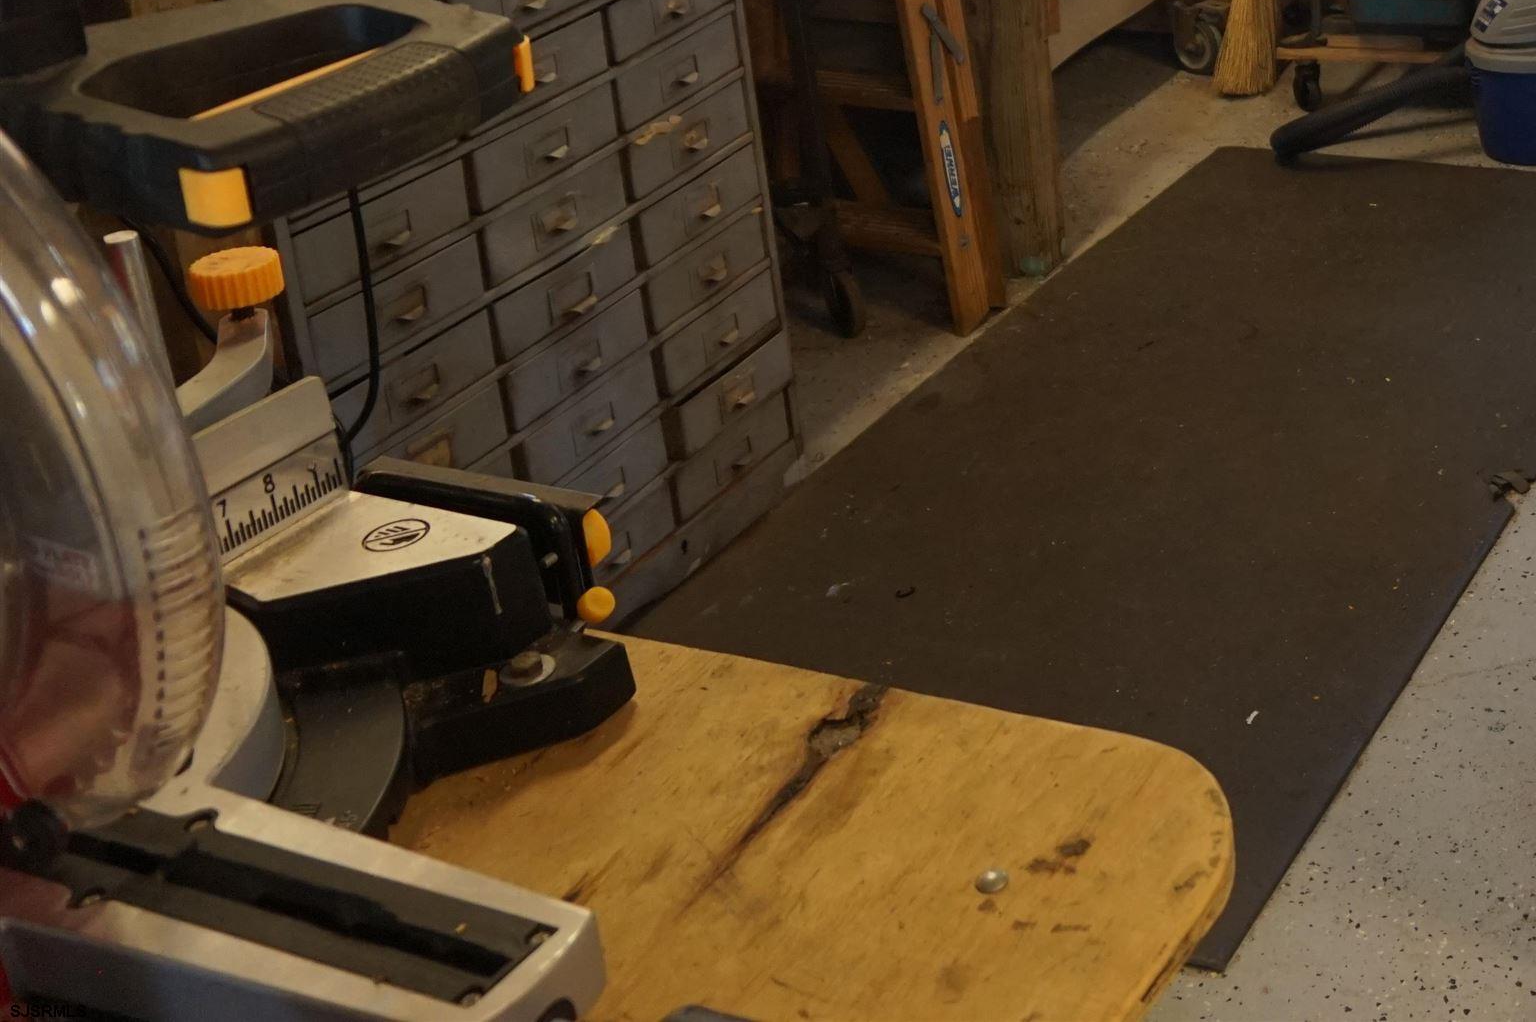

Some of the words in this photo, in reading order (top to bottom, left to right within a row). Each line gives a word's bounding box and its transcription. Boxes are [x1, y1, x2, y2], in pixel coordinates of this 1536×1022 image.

[944, 145, 961, 198] WERNE
[263, 473, 275, 494] 8
[216, 499, 227, 518] 7
